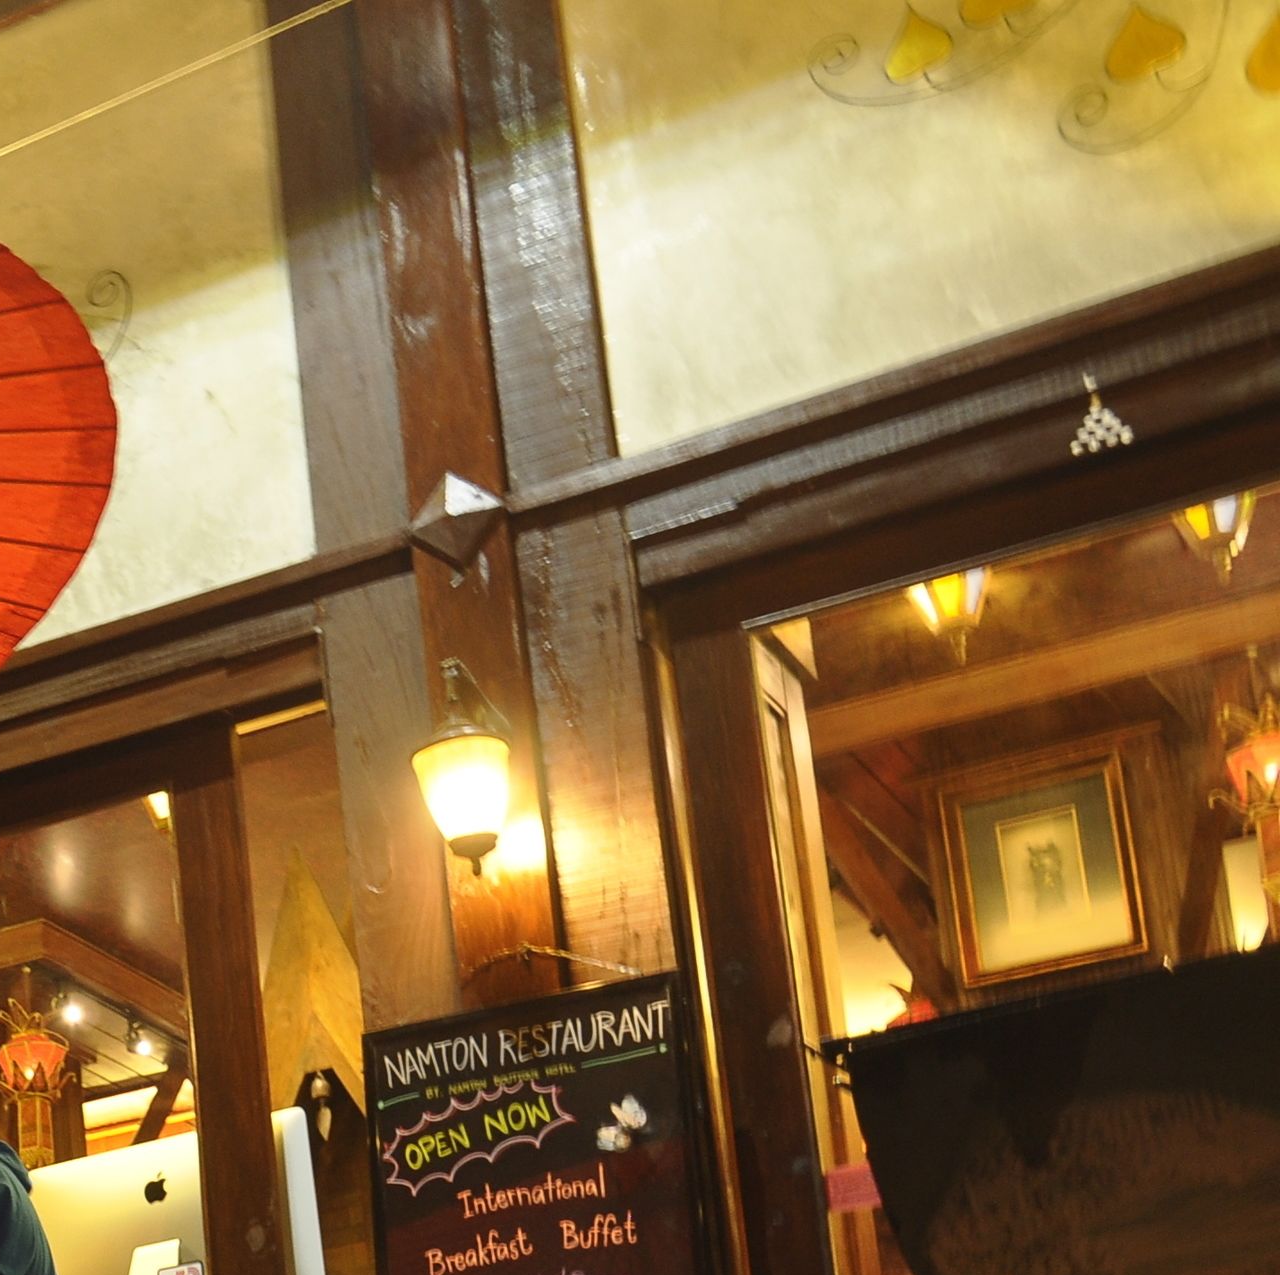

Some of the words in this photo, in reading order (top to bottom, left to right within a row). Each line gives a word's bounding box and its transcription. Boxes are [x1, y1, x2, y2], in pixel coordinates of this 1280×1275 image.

[383, 1032, 488, 1089] NAMTON
[498, 1000, 670, 1067] RESTAURANT
[404, 1123, 471, 1171] OPEN
[484, 1095, 551, 1141] NOW
[457, 1162, 607, 1219] International
[559, 1209, 638, 1250] Buffet
